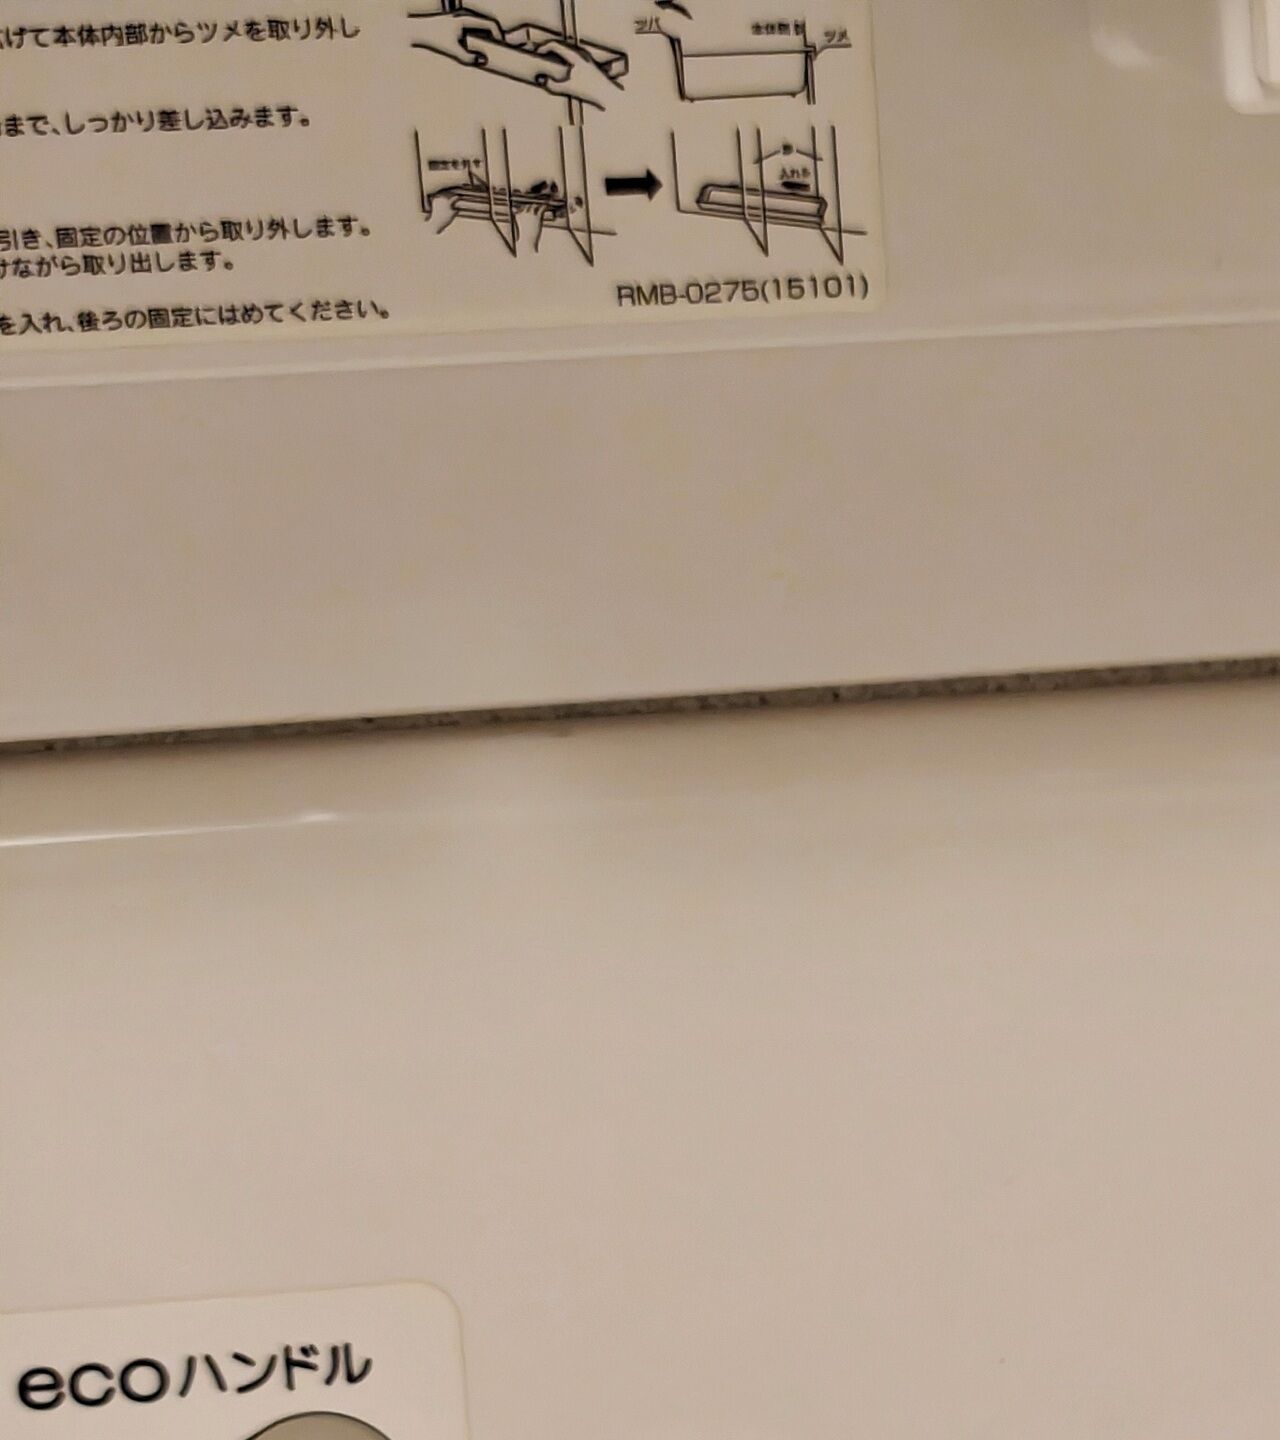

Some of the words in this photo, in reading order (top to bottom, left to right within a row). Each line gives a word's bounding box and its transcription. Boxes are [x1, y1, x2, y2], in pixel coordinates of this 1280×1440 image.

[0, 105, 310, 137] まで、しっかり差し込みます。
[617, 275, 869, 307] RMB-0275(15101)
